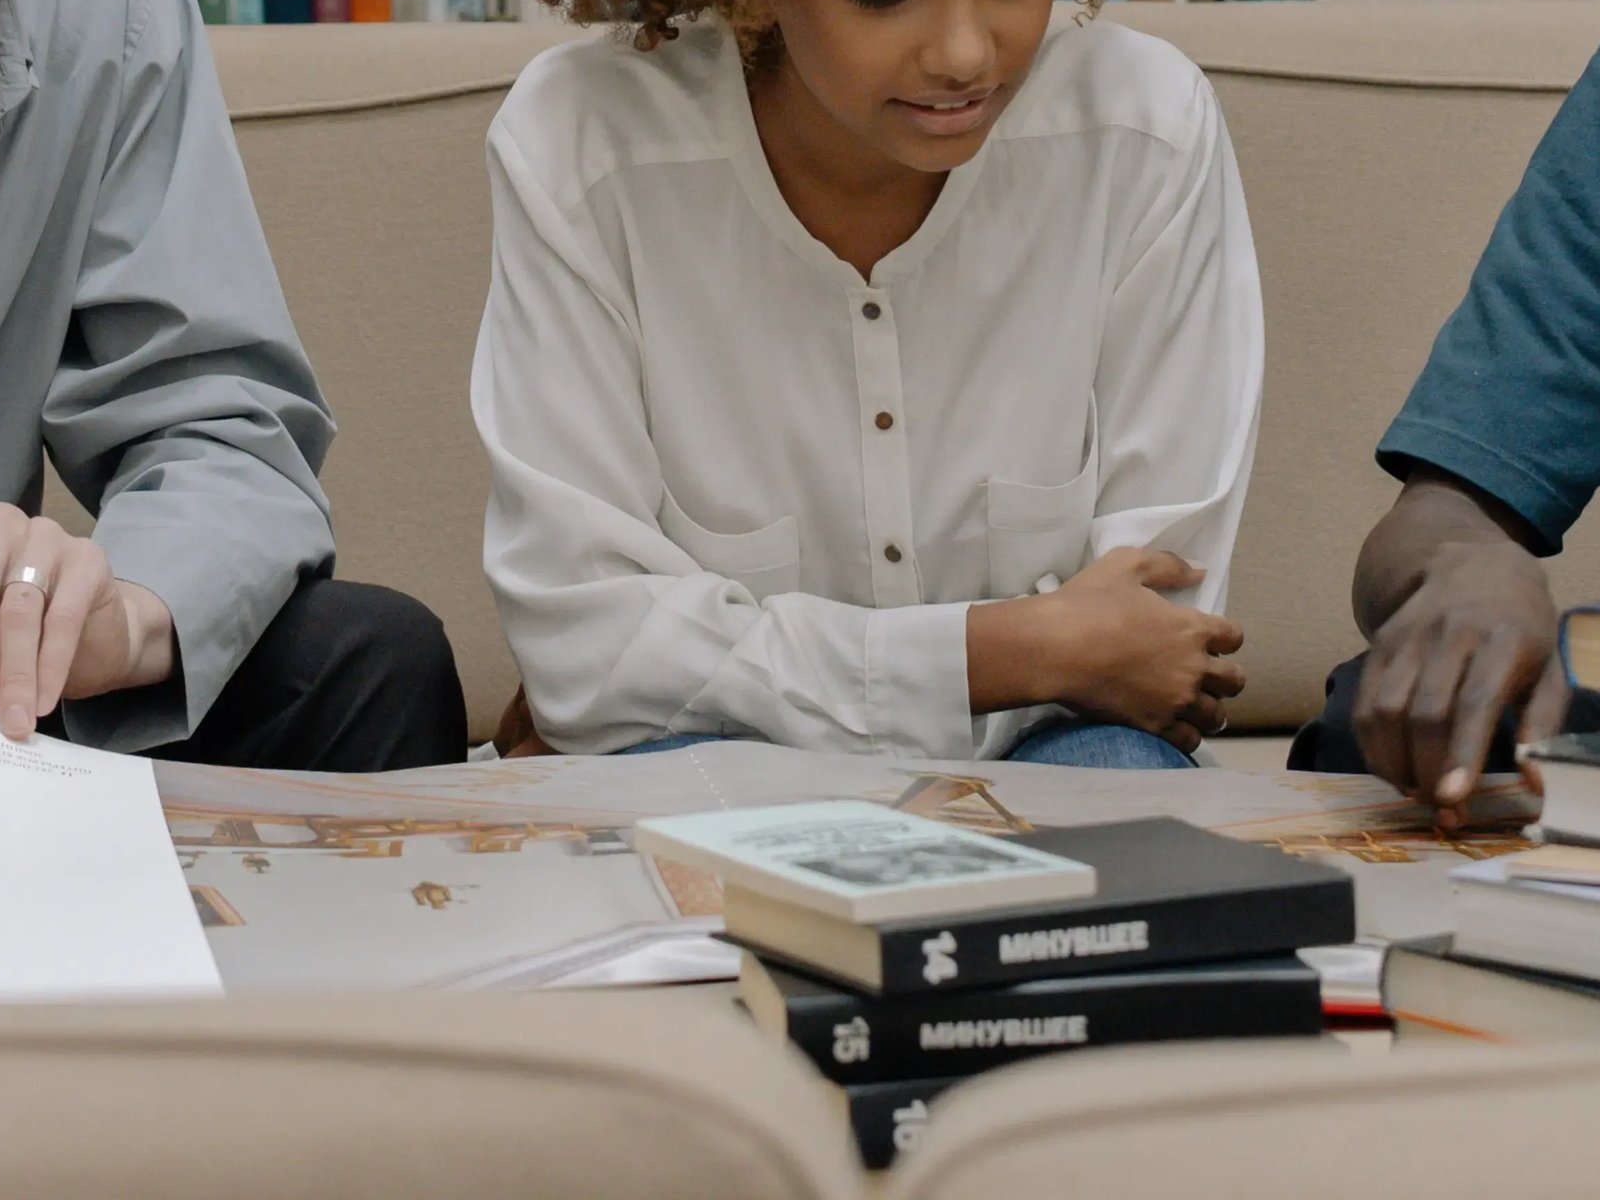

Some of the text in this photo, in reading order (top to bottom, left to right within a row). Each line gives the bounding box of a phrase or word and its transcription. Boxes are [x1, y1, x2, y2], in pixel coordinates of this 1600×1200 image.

[921, 930, 958, 985] 14
[999, 920, 1149, 964] МИНУВШЕЕ
[833, 1016, 870, 1063] 15
[920, 1014, 1088, 1051] МИНУВШЕЕ
